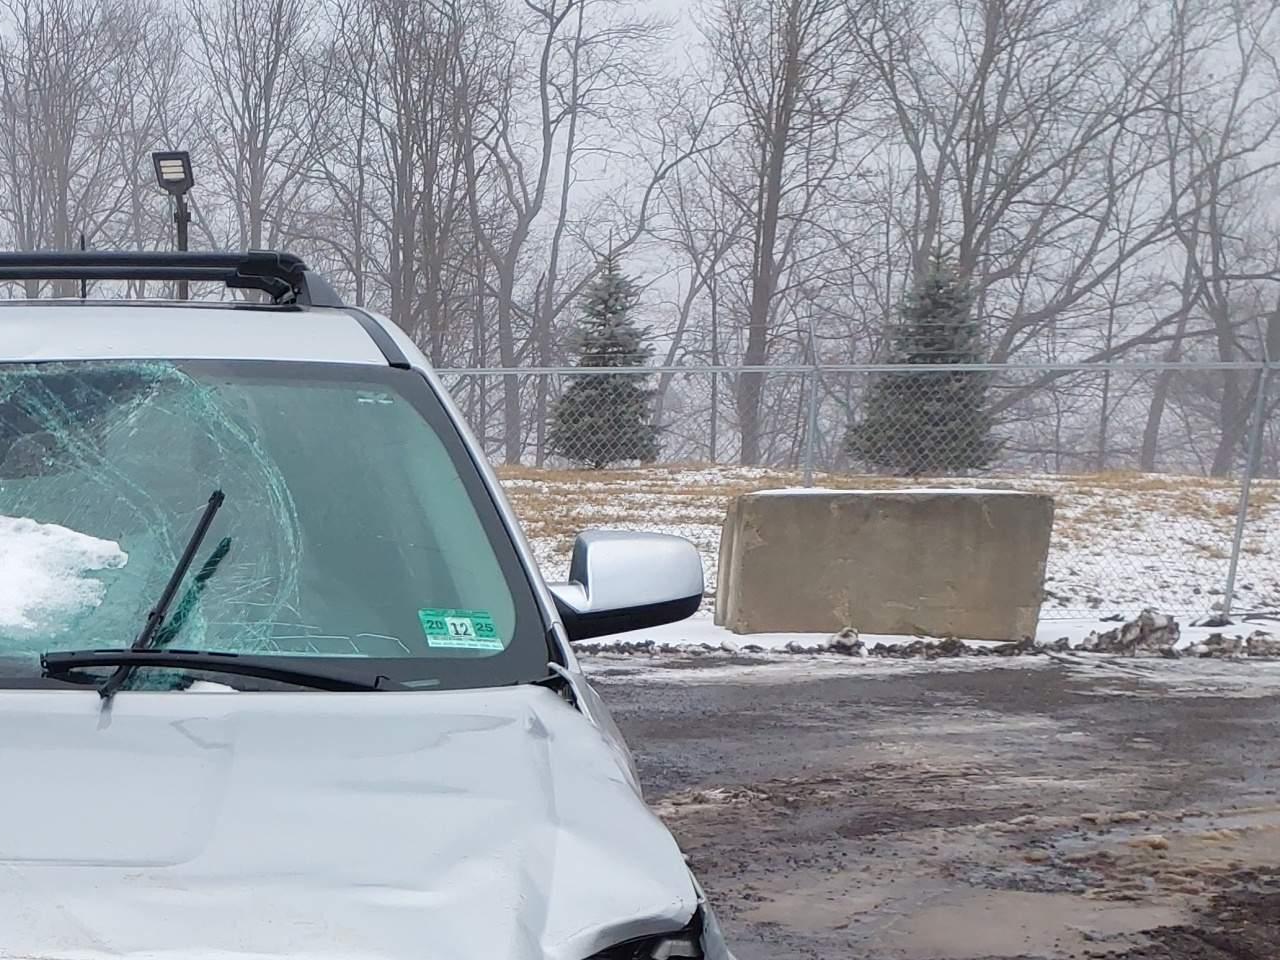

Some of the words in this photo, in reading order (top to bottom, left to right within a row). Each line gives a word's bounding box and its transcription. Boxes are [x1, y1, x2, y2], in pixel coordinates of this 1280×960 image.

[426, 620, 444, 630] 20
[450, 622, 473, 636] 12
[476, 623, 494, 633] 25
